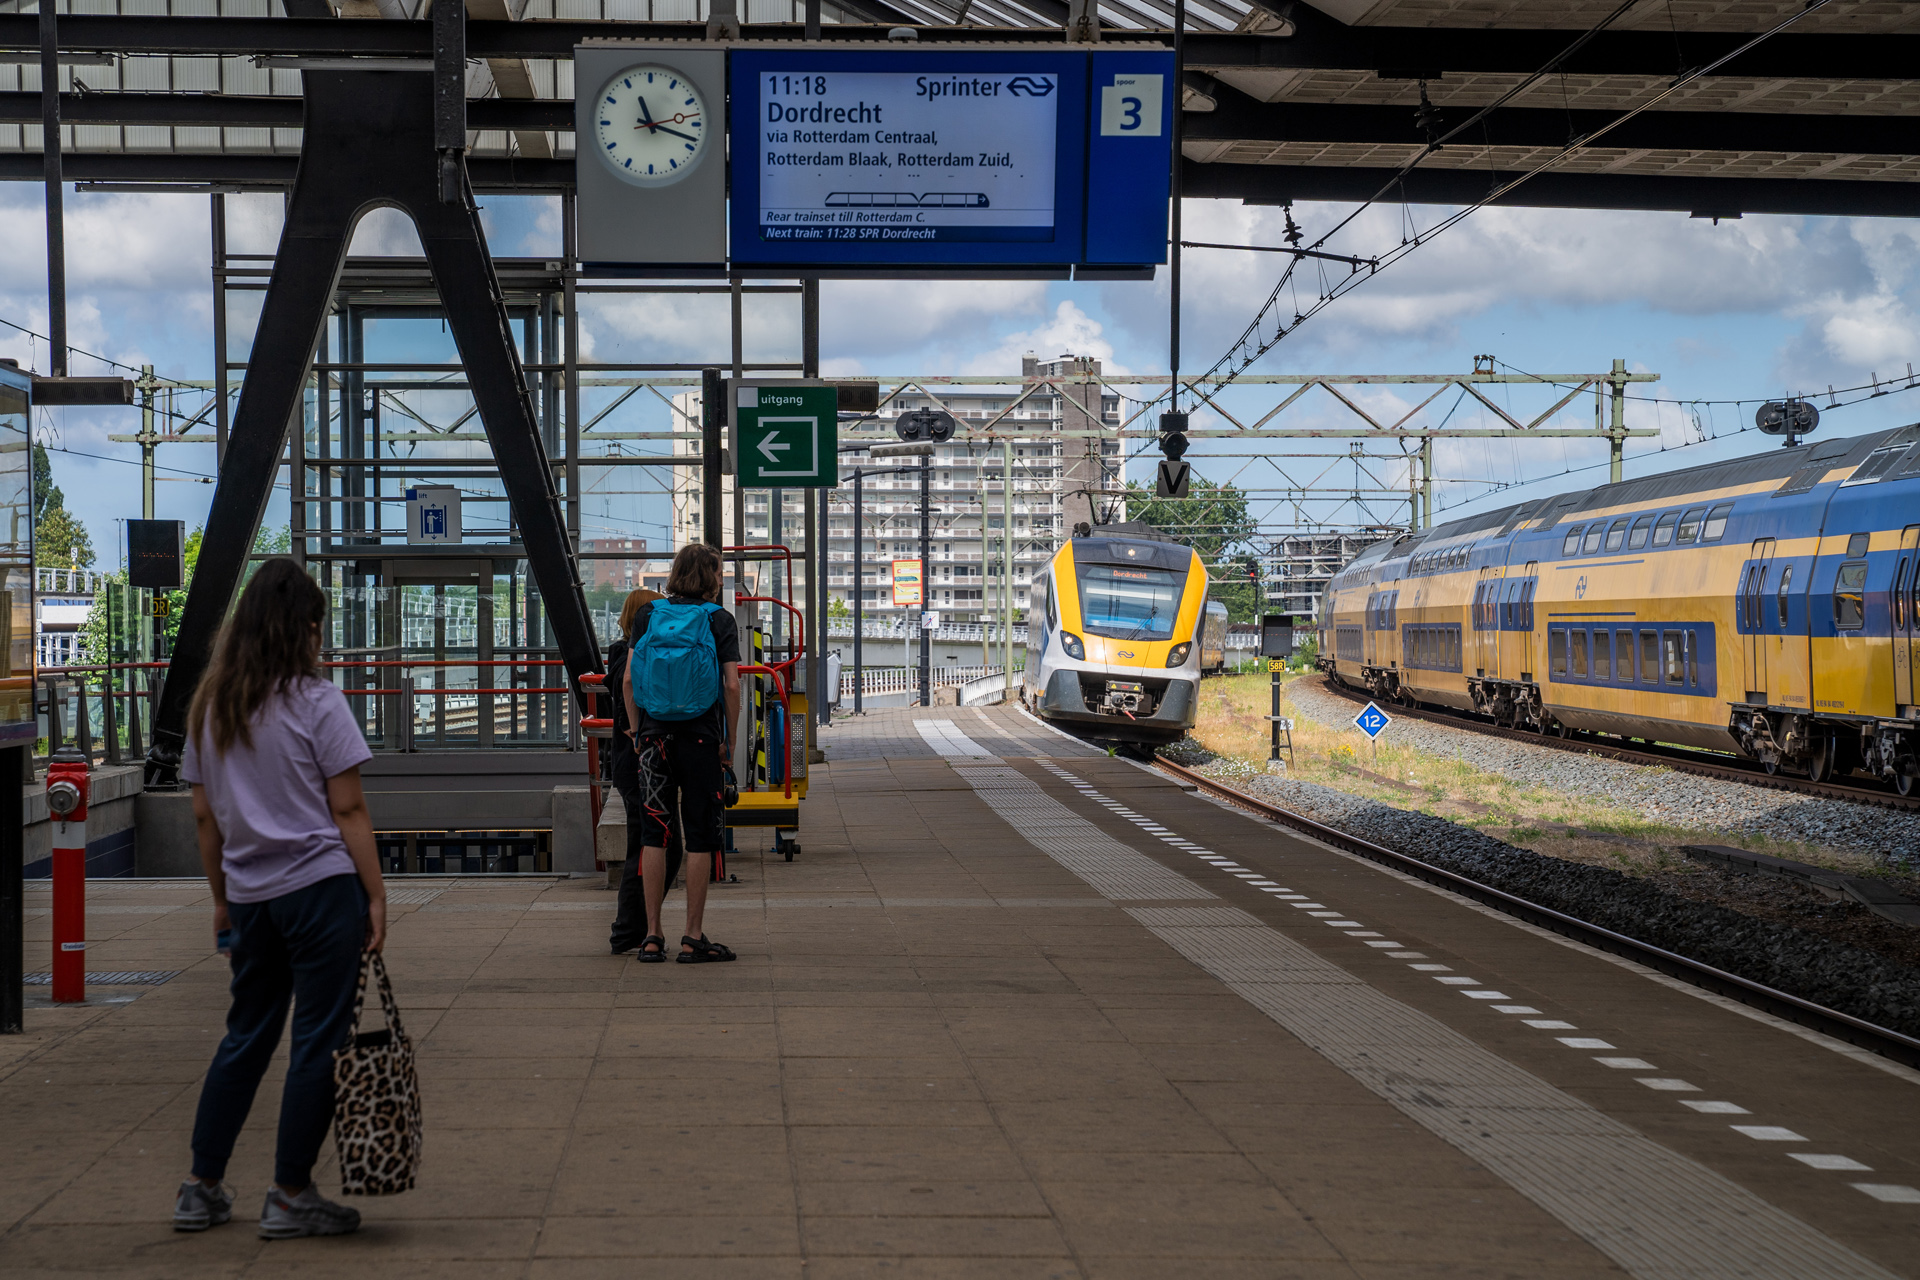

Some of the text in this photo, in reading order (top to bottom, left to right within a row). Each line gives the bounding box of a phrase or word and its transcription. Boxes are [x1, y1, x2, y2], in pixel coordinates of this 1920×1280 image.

[768, 75, 827, 95] 11:18
[916, 75, 1001, 101] Sprinter
[767, 101, 882, 123] Dordrecht
[1120, 96, 1142, 131] 3
[767, 130, 938, 146] via Rotterdam Centraal,
[767, 152, 1014, 169] Rotterdam Blaak, Rotterdam Zuid,
[766, 211, 926, 223] Rear trainset till Rotterdam C.
[766, 227, 936, 240] Next train: 11:28 SPR Dordrecht
[761, 394, 804, 406] uitgang
[1160, 464, 1189, 495] V
[1113, 569, 1148, 579] Dordrecht
[1683, 629, 1689, 653] 2
[1364, 714, 1381, 728] 12
